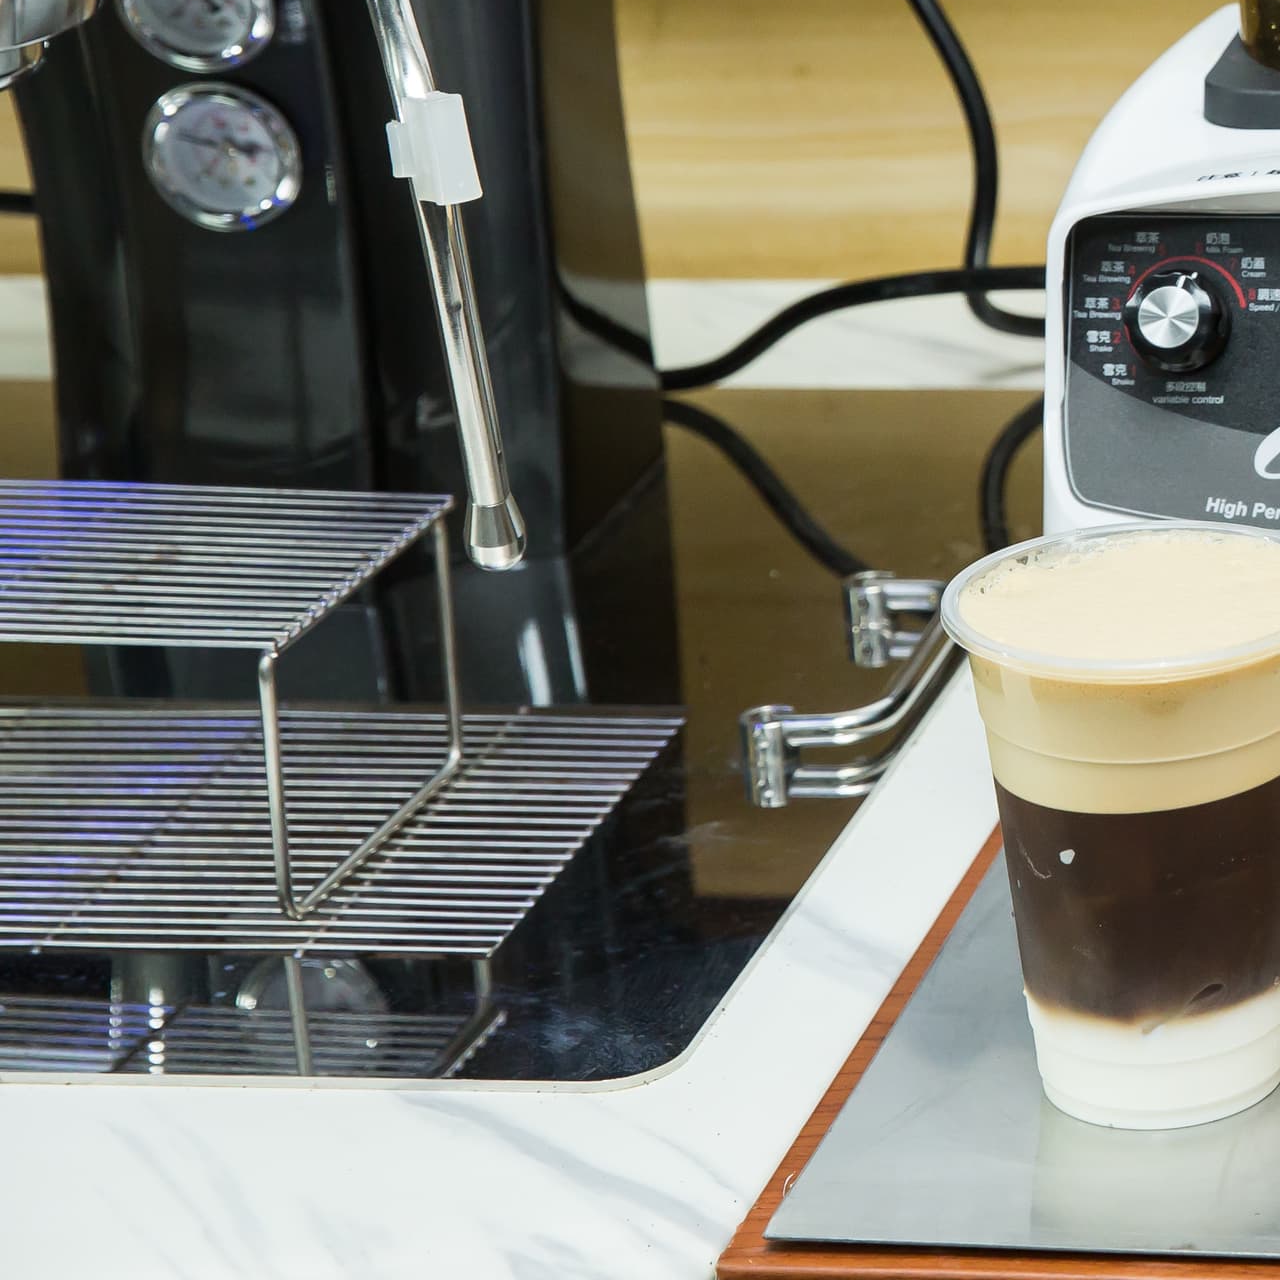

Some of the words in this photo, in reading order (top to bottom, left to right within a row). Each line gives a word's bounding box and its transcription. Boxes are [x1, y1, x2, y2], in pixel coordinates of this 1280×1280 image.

[1113, 330, 1122, 344] 2
[1191, 395, 1225, 404] control
[1206, 497, 1248, 520] High
